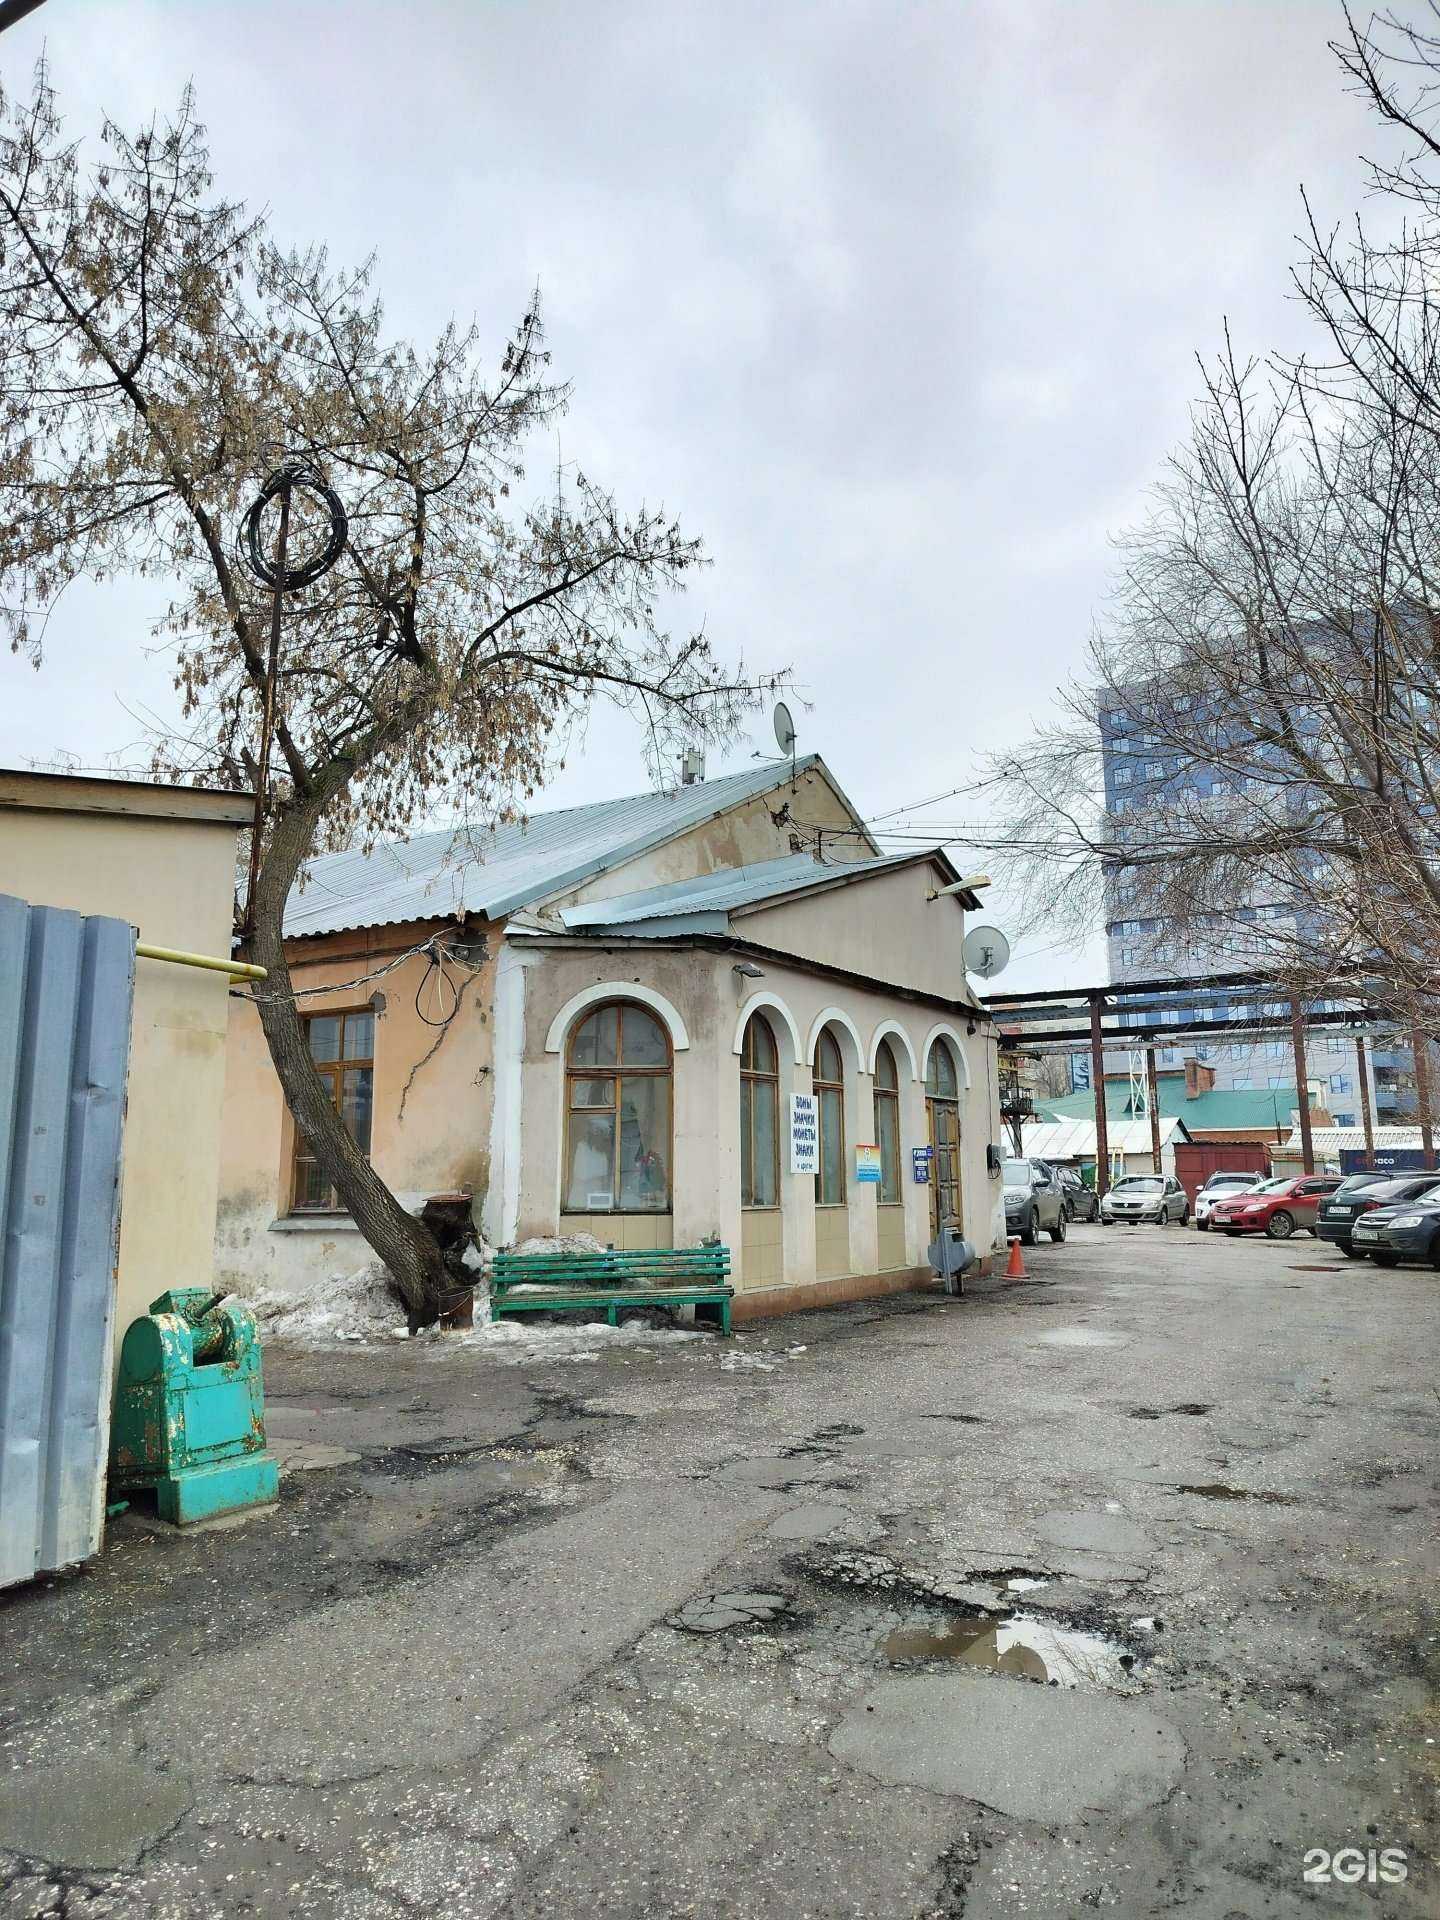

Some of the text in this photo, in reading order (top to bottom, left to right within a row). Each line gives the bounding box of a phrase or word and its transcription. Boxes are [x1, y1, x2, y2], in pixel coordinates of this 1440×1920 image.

[793, 1112, 815, 1126] ЗНАЧКИ
[793, 1127, 816, 1141] МОНЕТЫ
[795, 1144, 814, 1157] ЗНАКИ
